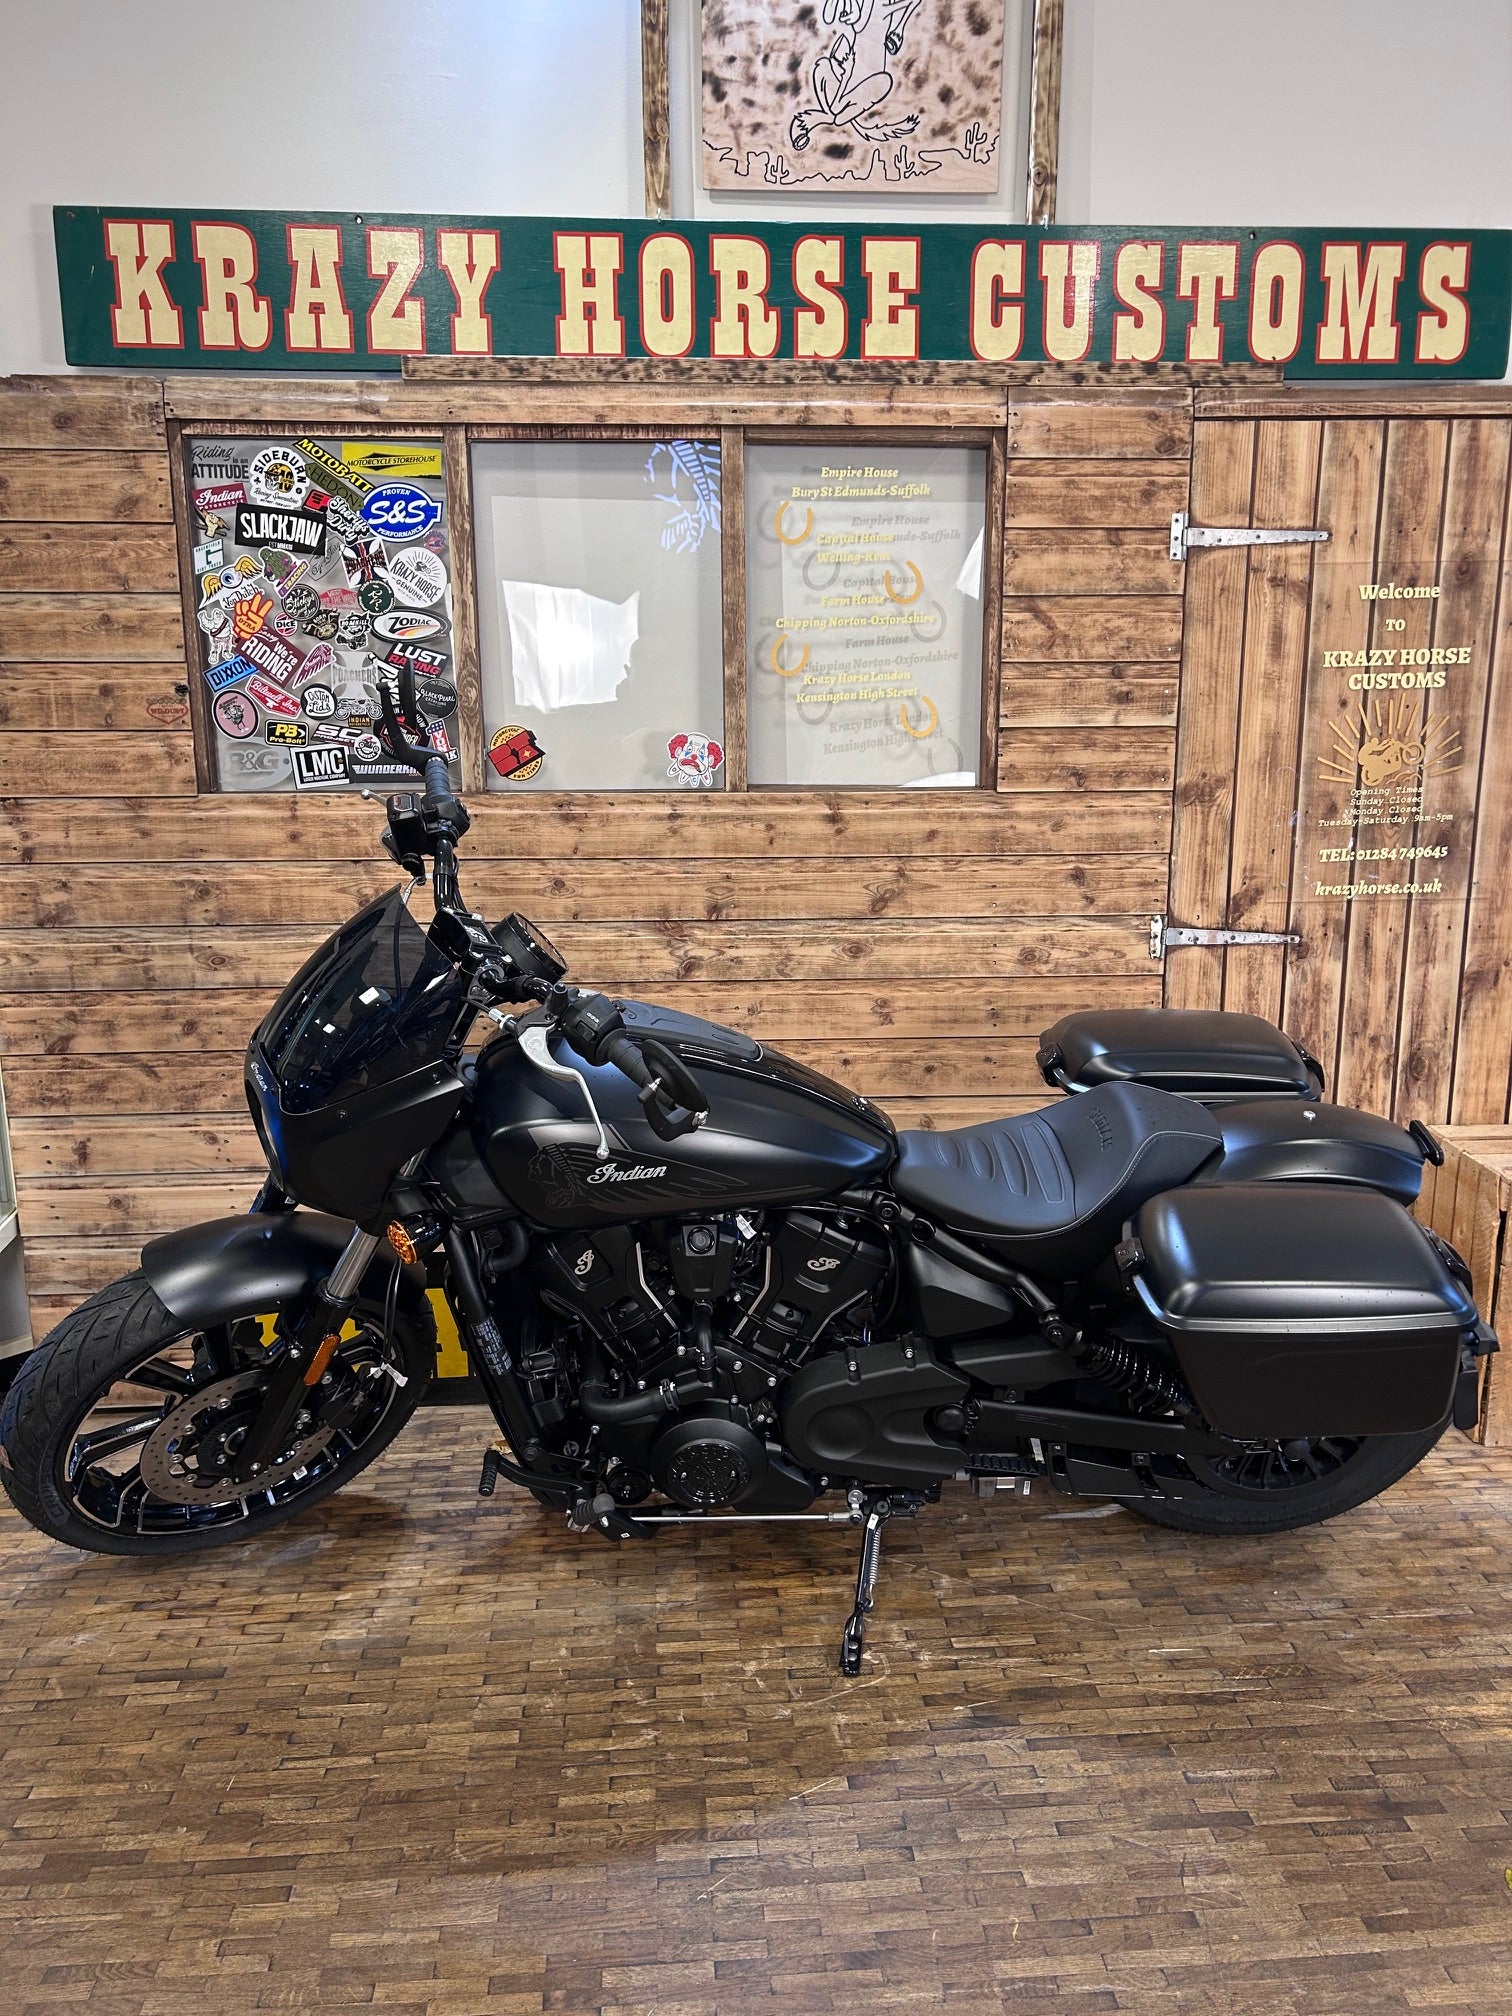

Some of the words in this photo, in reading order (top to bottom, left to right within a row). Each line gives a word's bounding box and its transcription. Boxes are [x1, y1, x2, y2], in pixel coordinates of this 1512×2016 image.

[103, 218, 500, 355] KRAZY
[553, 231, 921, 360] HORSE
[970, 239, 1472, 364] CUSTOMS
[192, 445, 234, 461] Riding
[347, 456, 392, 467] MOTORCYCLE
[392, 455, 437, 464] STOREHOUSE
[191, 463, 250, 479] ATTITUDE
[253, 450, 307, 484] SIDEBURN
[298, 438, 374, 493] MOTOBATT
[821, 466, 862, 480] Empire
[864, 466, 899, 478] House
[311, 466, 359, 507] HEDON
[382, 488, 411, 496] PROVEN
[792, 486, 819, 499] Bury
[821, 486, 833, 497] St
[834, 484, 930, 498] Edmunds-Suffolk
[195, 489, 243, 506] Indian
[367, 500, 427, 525] S&S
[240, 512, 323, 547] SLACKJAW
[377, 525, 424, 538] PERFORMANCE
[860, 532, 894, 544] House
[390, 557, 419, 583] KRAZY
[414, 576, 442, 603] HORSE
[396, 579, 423, 601] GENUINE
[1359, 583, 1440, 600] Welcome
[821, 594, 850, 606] Farm
[852, 594, 886, 605] House
[389, 616, 432, 634] ZODIAC
[775, 617, 826, 631] Chipping
[829, 613, 935, 628] Norton-Oxfordshire
[1385, 619, 1406, 631] TO
[241, 637, 293, 681] RIDING
[274, 641, 298, 666] We're
[393, 643, 447, 665] LUST
[1323, 650, 1397, 668] KRAZY
[1399, 647, 1471, 666] HORSE
[210, 659, 252, 686] DIXXON
[803, 674, 836, 685] Krazy
[839, 673, 869, 683] Horse
[871, 671, 910, 682] London
[1348, 671, 1446, 690] CUSTOMS
[307, 690, 330, 702] CUSTOM
[796, 691, 857, 704] Kensington
[859, 689, 885, 702] High
[887, 687, 918, 698] Street
[275, 724, 298, 737] PB
[299, 750, 345, 777] LMC
[1350, 788, 1390, 797] Opening
[1350, 797, 1384, 807] Sunday
[1389, 796, 1423, 804] Closed
[1350, 807, 1384, 817] Monday
[1389, 805, 1423, 814] Closed
[1318, 816, 1408, 827] Tuesday-Saturday
[1414, 814, 1453, 823] 9am-5pm
[1356, 847, 1398, 861] 01284
[1400, 846, 1448, 860] 749645
[1315, 878, 1442, 899] krazyhorse.co.uk
[587, 1163, 667, 1184] Indian
